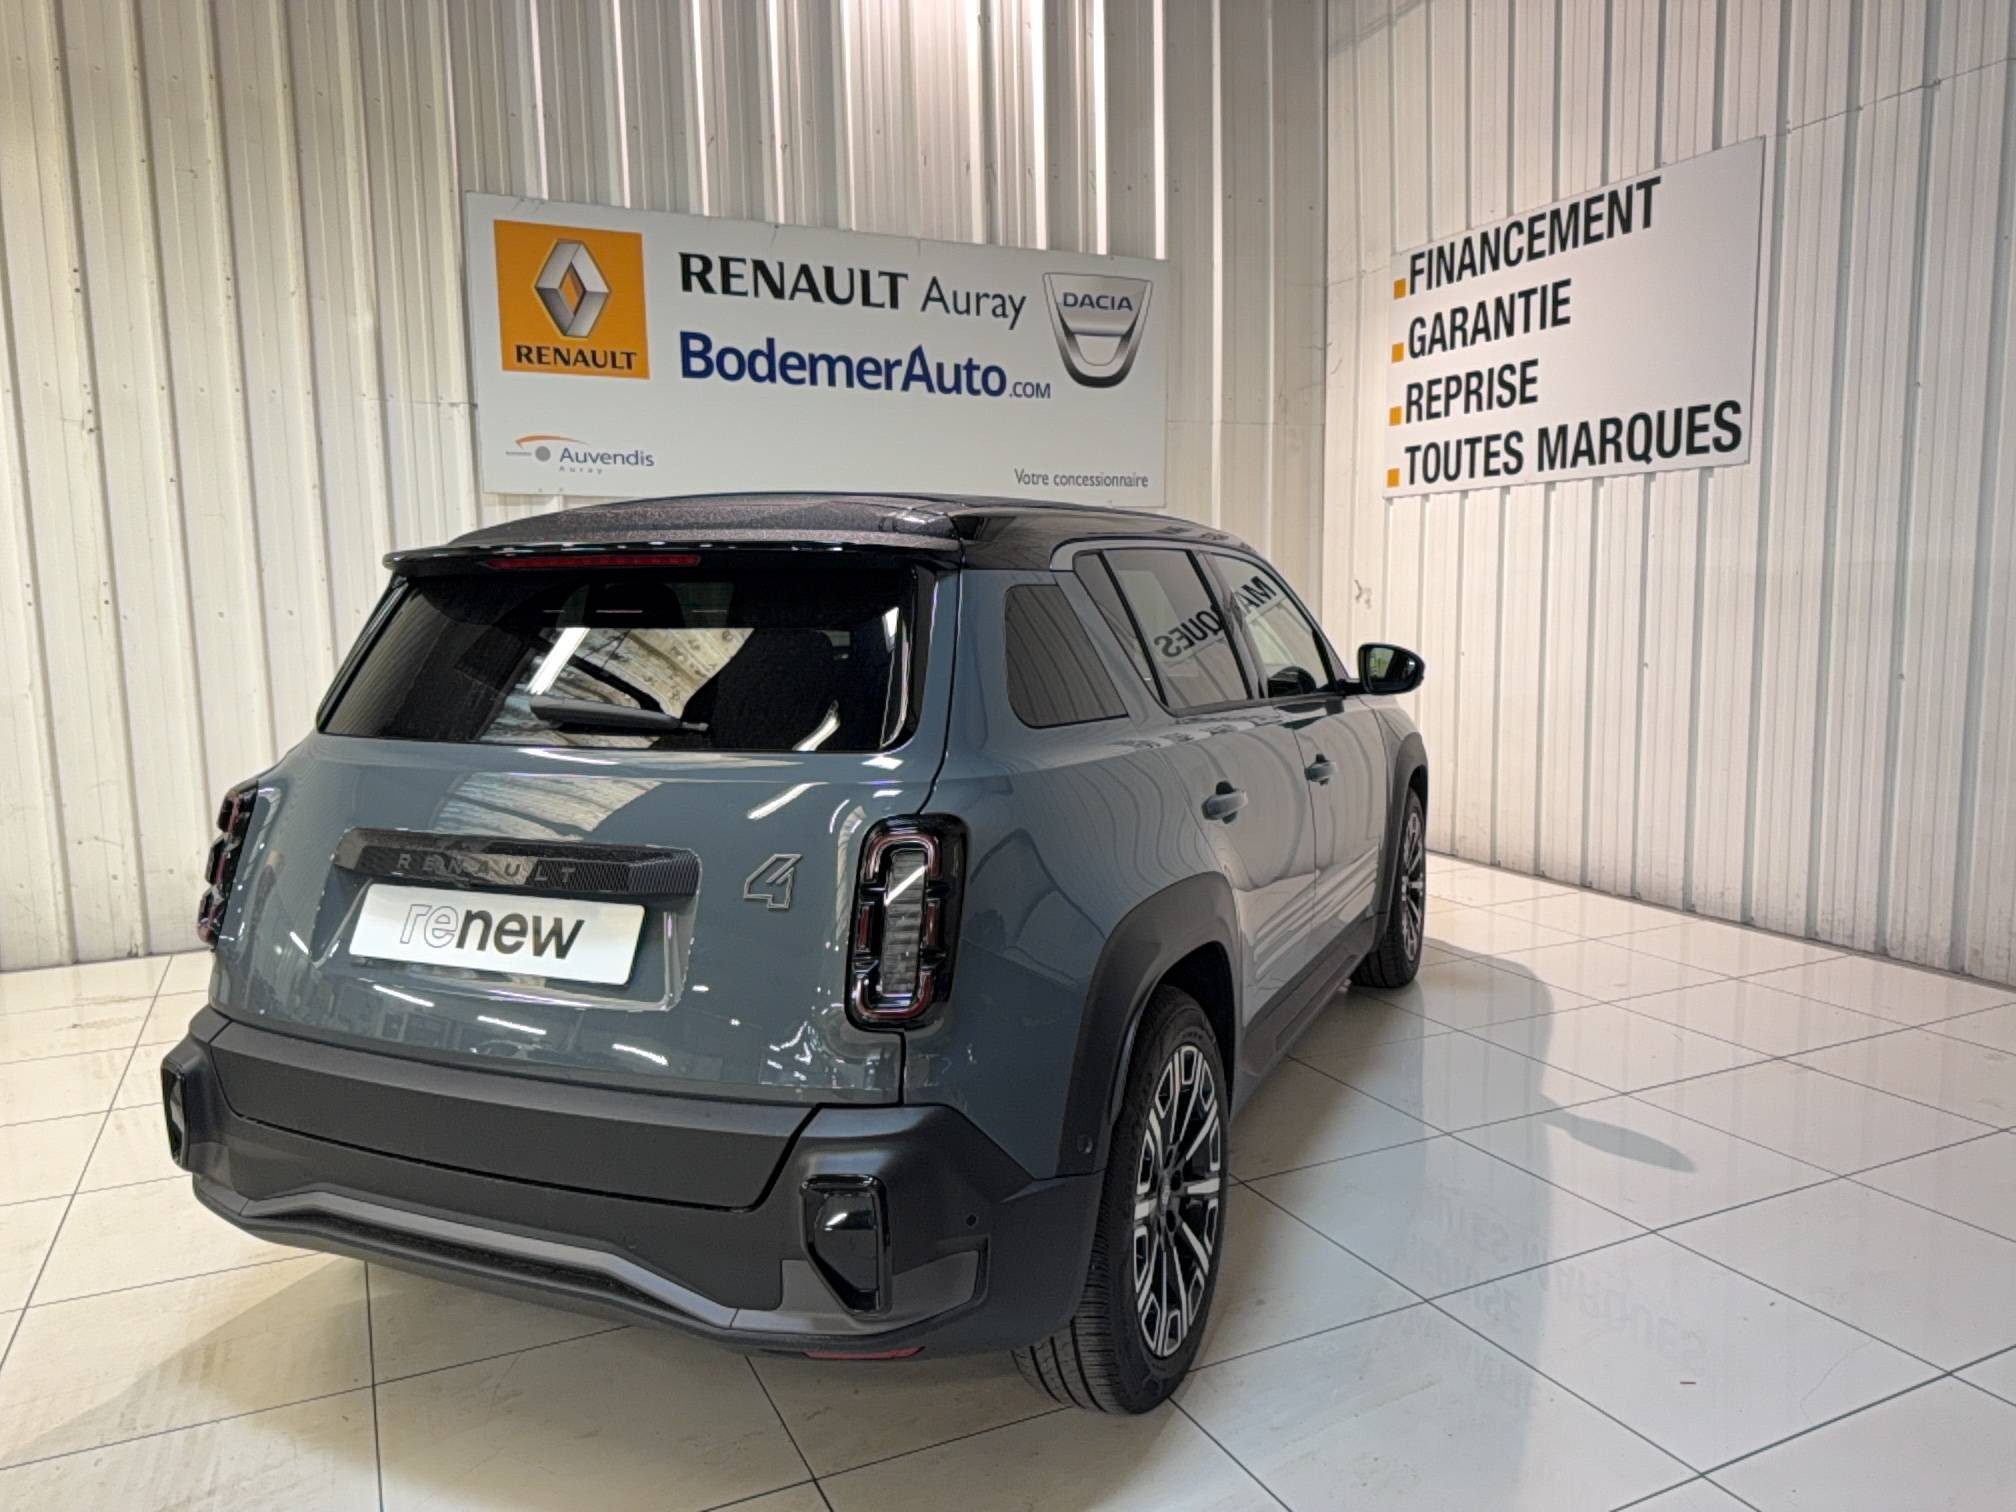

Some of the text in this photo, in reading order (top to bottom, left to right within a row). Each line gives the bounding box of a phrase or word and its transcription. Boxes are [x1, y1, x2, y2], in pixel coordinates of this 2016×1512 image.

[1409, 176, 1661, 295] FINANCEMENT
[678, 252, 1027, 331] RENAULT Auray
[1062, 291, 1134, 312] DACIA
[1408, 278, 1572, 359] GARANTIE
[515, 343, 638, 371] RENAULT
[1405, 358, 1539, 425] REPRISE
[559, 447, 655, 467] Auvendis
[1404, 399, 1742, 485] TOUTES MARQUES
[1014, 468, 1149, 489] Votre concessionnaire
[397, 852, 576, 883] RENAULT
[399, 903, 585, 961] renew
